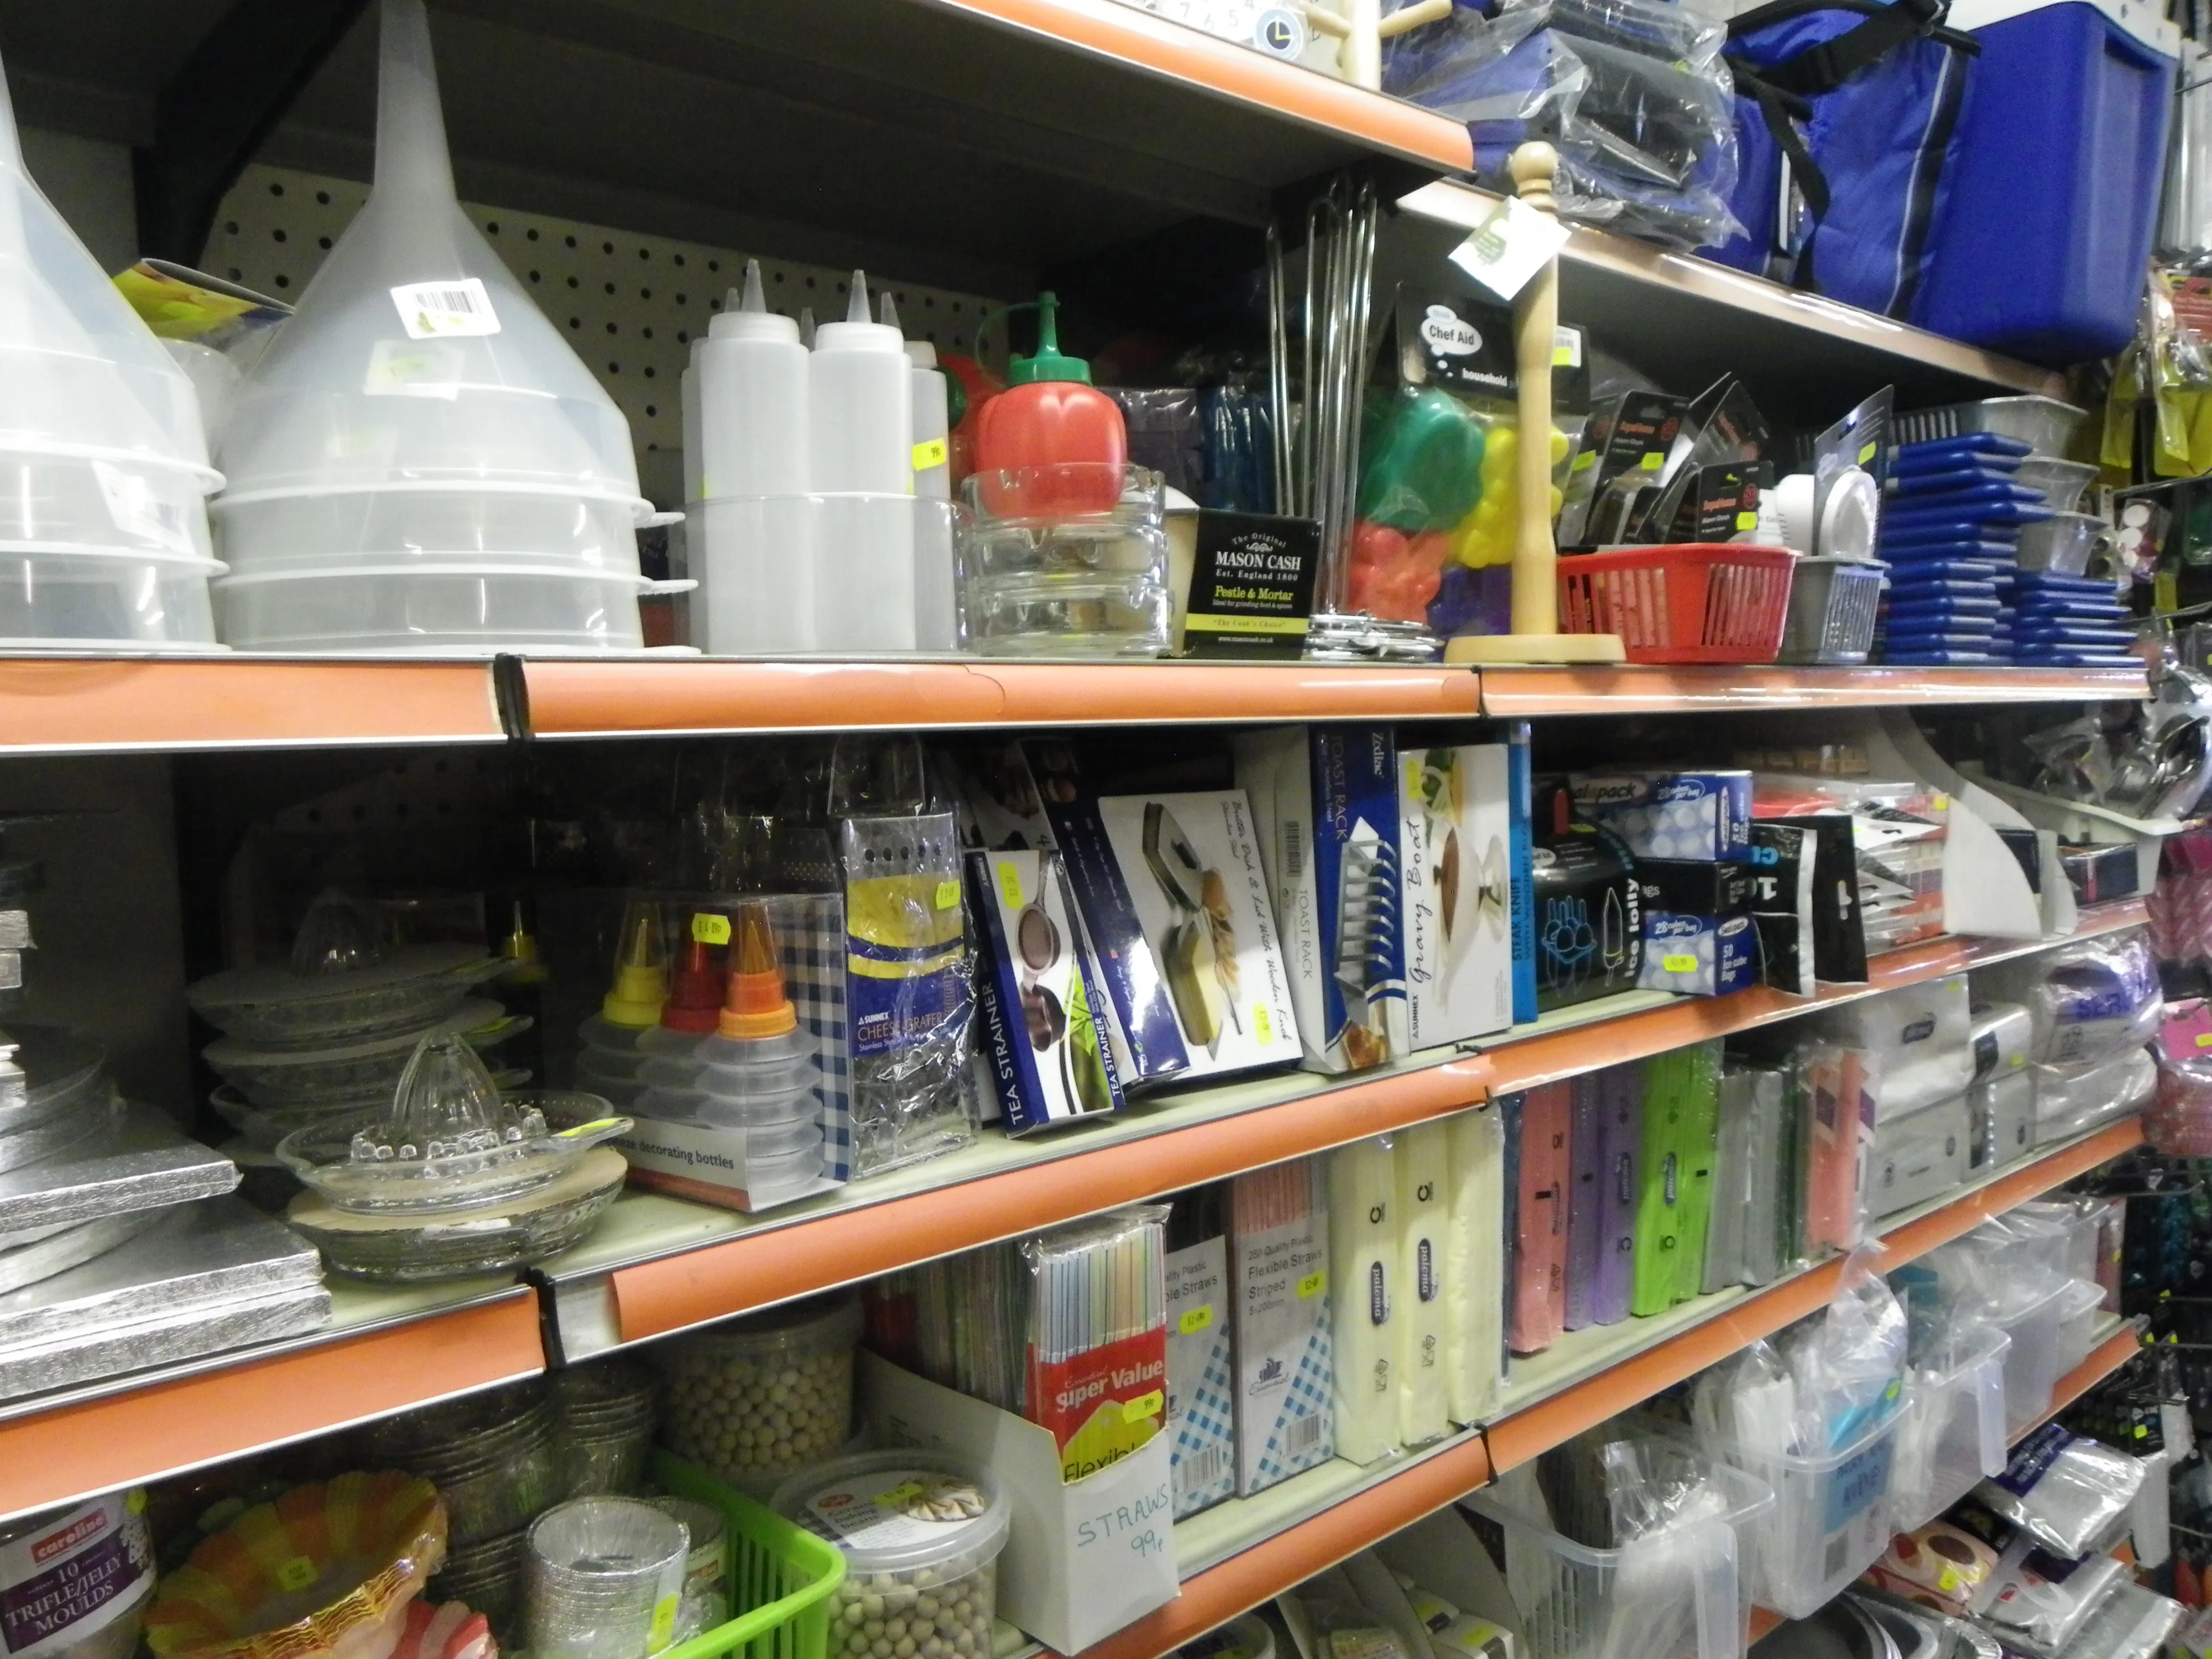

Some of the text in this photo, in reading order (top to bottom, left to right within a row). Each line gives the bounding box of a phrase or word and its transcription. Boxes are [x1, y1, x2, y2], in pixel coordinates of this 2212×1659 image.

[1429, 325, 1475, 346] Chef Aid
[1462, 367, 1508, 387] household
[1232, 532, 1287, 548] The Original
[1215, 551, 1302, 571] MASON CASH
[1216, 568, 1234, 577] Est.
[1238, 570, 1273, 580] England
[1214, 585, 1294, 601] Pestle & Mortar
[1331, 735, 1348, 840] TOAST RACK
[1406, 816, 1423, 891] Boat
[1510, 876, 1522, 961] STEAK KNIFE
[1625, 878, 1640, 978] Ice lolly
[1655, 922, 1668, 934] 28
[1299, 888, 1313, 980] TOAST RACK
[1409, 900, 1433, 984] Gravy
[1723, 943, 1734, 958] 50
[1266, 957, 1279, 1004] Wooden
[1277, 1009, 1293, 1041] Knob
[864, 1011, 889, 1024] SUNNEX
[905, 1012, 943, 1032] GRATER
[859, 1041, 883, 1052] Stainless
[983, 981, 1024, 1126] TEA STRAINER
[1095, 1016, 1117, 1071] STRAINER
[1110, 1074, 1121, 1097] TEA
[639, 1139, 694, 1165] decorating
[695, 1150, 734, 1170] bottles
[1248, 1234, 1314, 1261] 250 Quality Plastic
[1182, 1260, 1207, 1276] Plastic
[1248, 1248, 1323, 1280] Flexible Straws
[1420, 1245, 1430, 1294] paloma
[1182, 1275, 1218, 1297] Straws
[1248, 1277, 1286, 1300] Striped
[1372, 1267, 1382, 1318] paloma
[1055, 1359, 1164, 1413] Super Value
[1077, 1483, 1170, 1548] STRAWS
[36, 1514, 105, 1558] caroline
[1130, 1529, 1164, 1558] 99p
[58, 1562, 80, 1584] 10
[5, 1553, 122, 1627] TRIFLE/JELLY
[34, 1579, 114, 1635] MOULDS
